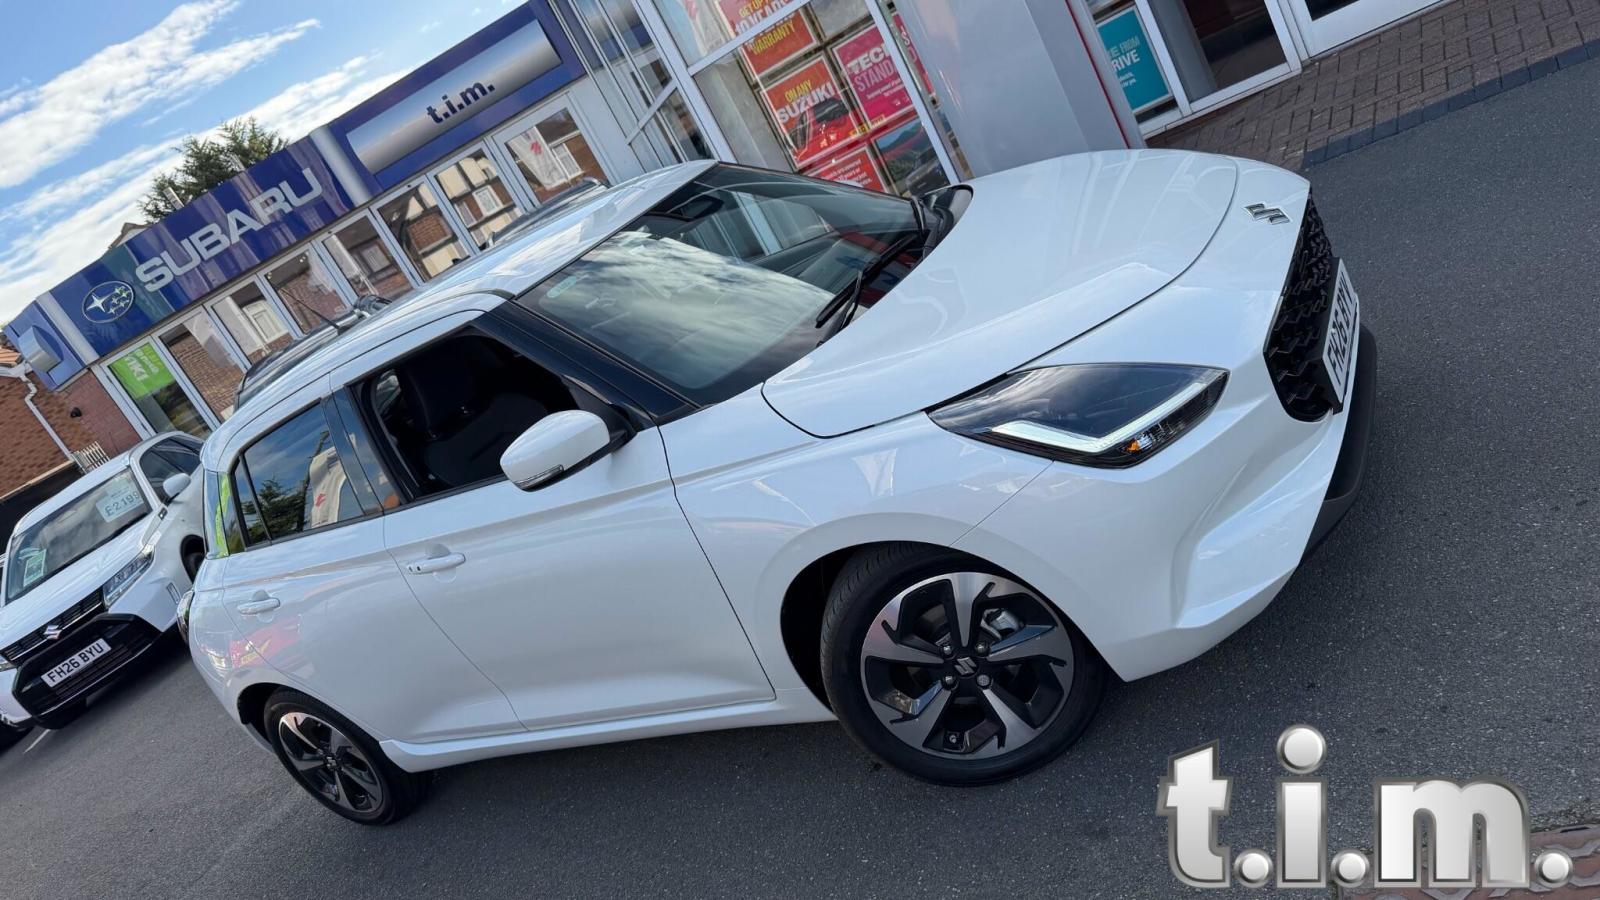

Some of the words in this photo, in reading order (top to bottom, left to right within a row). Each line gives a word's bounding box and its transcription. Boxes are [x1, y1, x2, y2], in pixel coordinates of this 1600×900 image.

[752, 20, 795, 55] WARRANTY
[785, 87, 798, 102] ON
[796, 80, 812, 98] ANY
[854, 60, 897, 91] STAND
[426, 82, 495, 124] t.i.m.
[776, 82, 835, 123] SUZUKI
[135, 167, 323, 292] SUBARU
[1327, 308, 1347, 386] FH26
[47, 658, 80, 682] FH26
[78, 643, 104, 663] BYU
